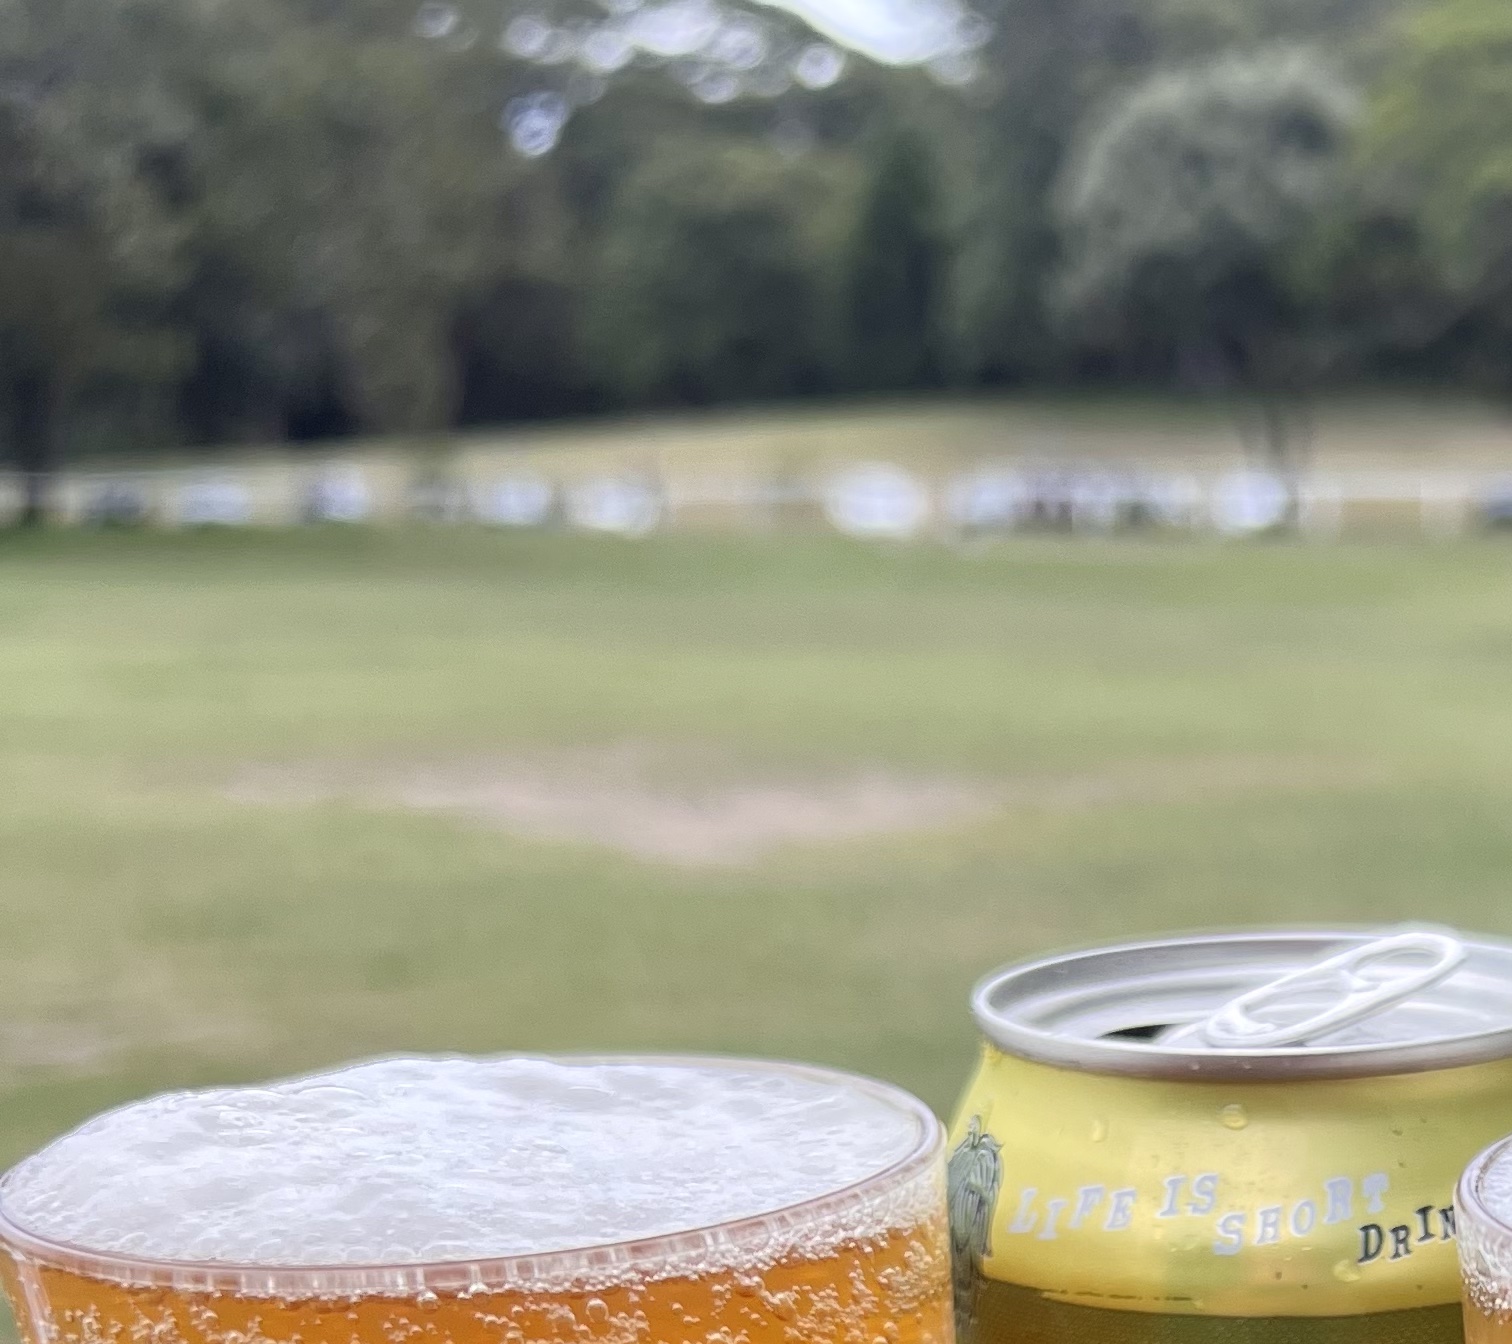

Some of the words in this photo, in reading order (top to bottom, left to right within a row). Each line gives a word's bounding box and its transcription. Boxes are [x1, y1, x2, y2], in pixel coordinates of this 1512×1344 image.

[1008, 1184, 1137, 1241] LIFE
[1158, 1172, 1220, 1219] IS
[1212, 1172, 1390, 1257] SHORT
[1357, 1203, 1457, 1264] DRIN
